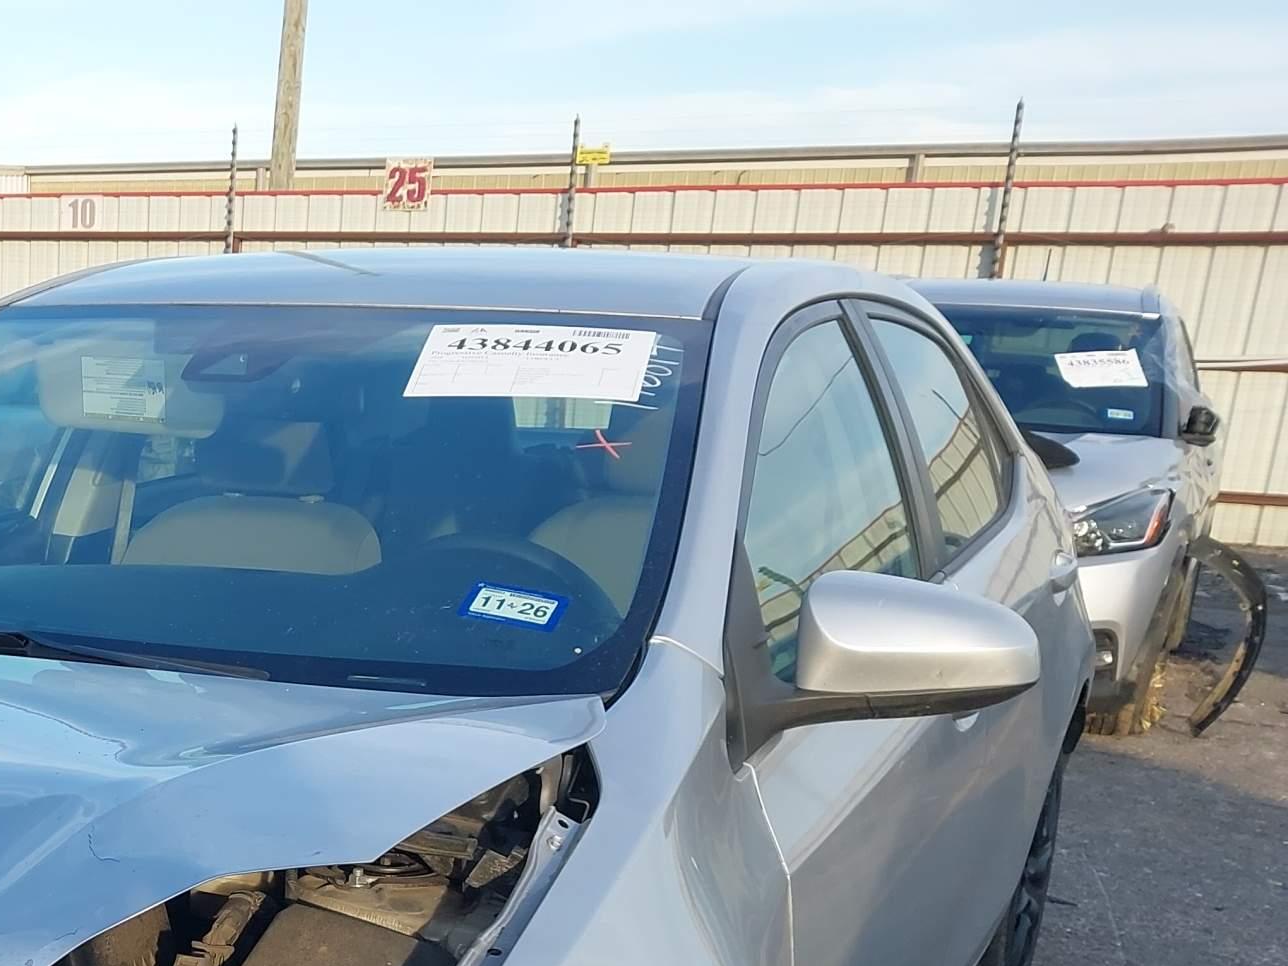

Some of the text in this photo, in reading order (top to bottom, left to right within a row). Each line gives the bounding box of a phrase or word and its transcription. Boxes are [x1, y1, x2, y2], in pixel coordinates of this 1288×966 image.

[386, 166, 427, 204] 25
[68, 199, 96, 229] 10
[447, 337, 623, 356] 43844065
[516, 602, 551, 619] 26
